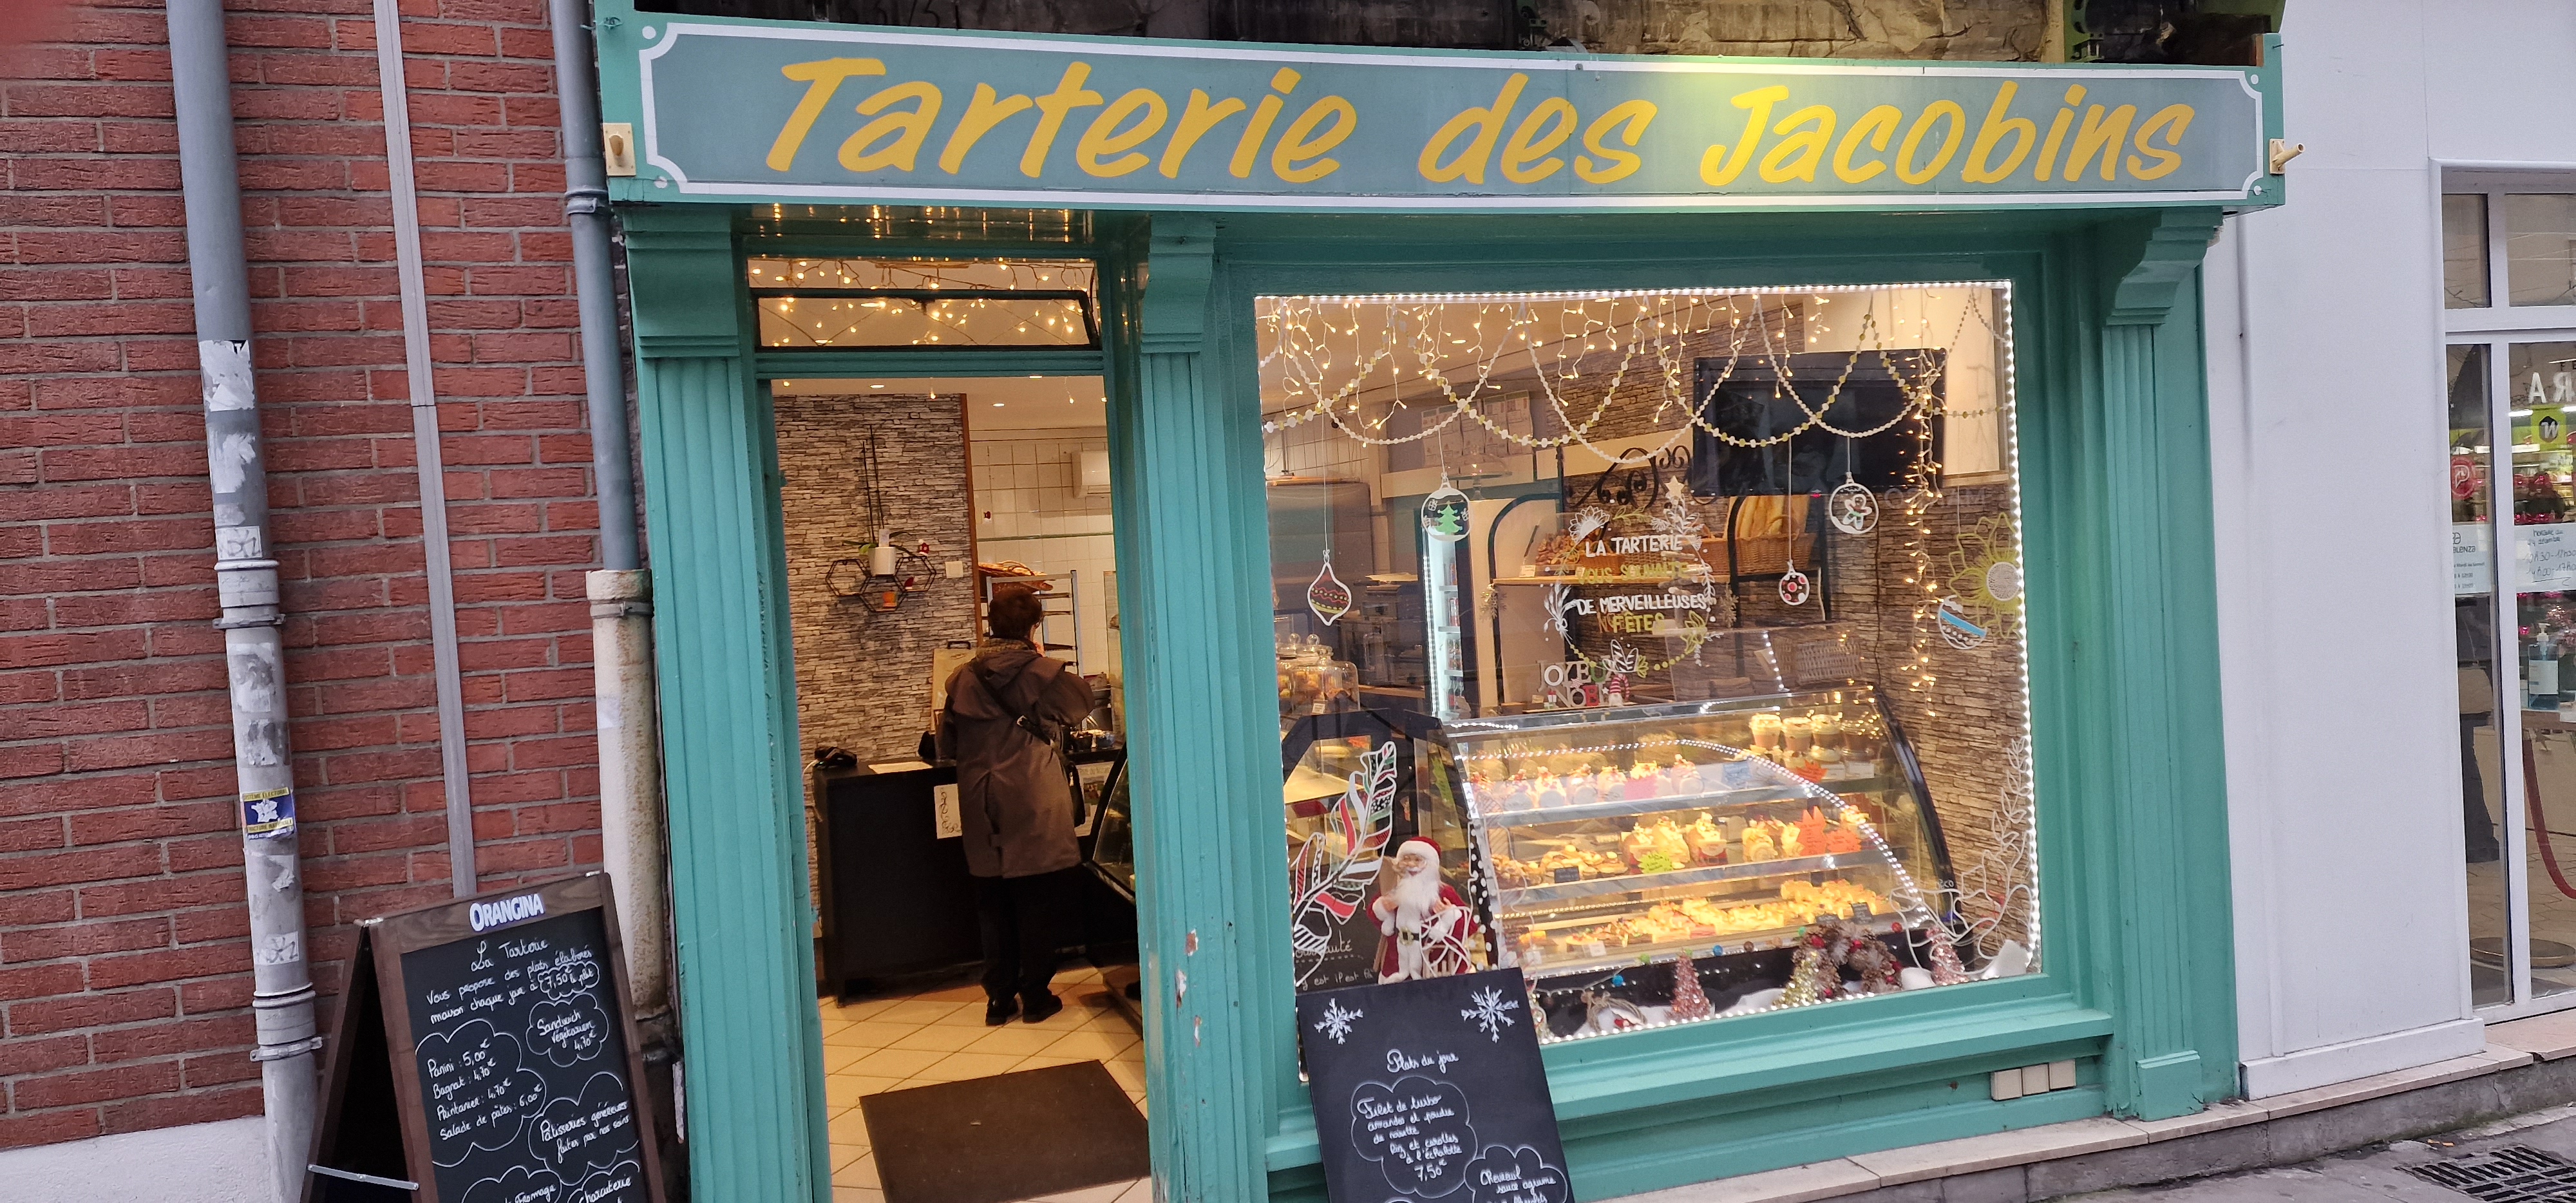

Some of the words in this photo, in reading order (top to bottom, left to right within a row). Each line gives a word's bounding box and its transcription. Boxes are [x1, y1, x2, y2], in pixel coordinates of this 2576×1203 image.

[766, 57, 1357, 183] Tarterie
[1417, 72, 1658, 185] des
[1700, 80, 2195, 187] Jacobins
[1586, 540, 1606, 558] LA
[1611, 534, 1683, 554] TARTERIE
[1577, 567, 1614, 585] VOUS
[1620, 561, 1689, 581] SOUHAITE
[1577, 599, 1597, 616] DE
[1600, 593, 1707, 613] MERVEILLEUSES
[1613, 609, 1665, 634] FÊTES
[469, 893, 545, 932] ORANGINA
[471, 940, 494, 972] La
[498, 937, 550, 959] Tarterie
[426, 990, 451, 1005] Vous
[459, 978, 495, 1000] propose
[504, 969, 520, 981] des
[527, 960, 549, 979] plats
[430, 1003, 464, 1025] maison
[470, 993, 504, 1011] chaque
[537, 1009, 581, 1036] Sandwich
[1387, 1048, 1419, 1073] Plats
[1421, 1053, 1435, 1067] du
[1436, 1049, 1459, 1074] jour
[1357, 1096, 1394, 1119] Filet
[1396, 1099, 1408, 1113] de
[1410, 1111, 1421, 1124] et
[476, 1115, 488, 1127] de
[556, 1137, 580, 1164] faites
[583, 1132, 597, 1148] par
[599, 1124, 611, 1135] nos
[1408, 1137, 1421, 1151] et
